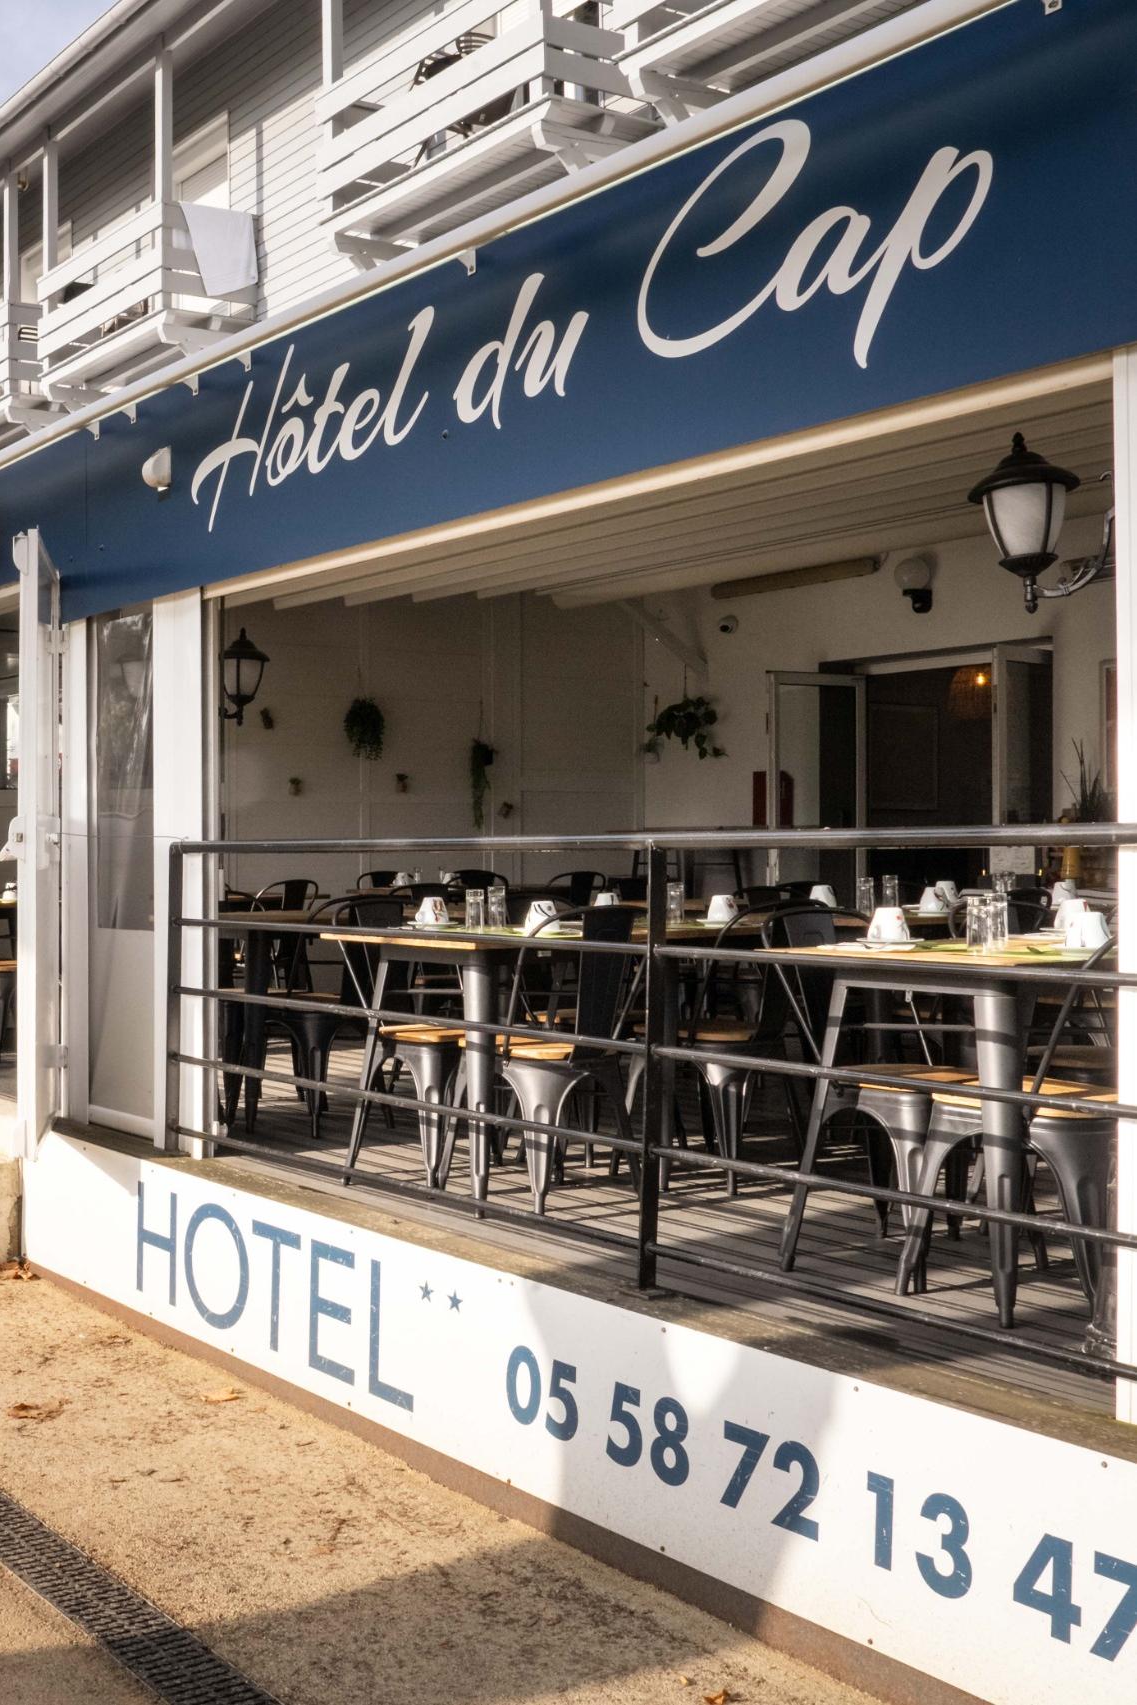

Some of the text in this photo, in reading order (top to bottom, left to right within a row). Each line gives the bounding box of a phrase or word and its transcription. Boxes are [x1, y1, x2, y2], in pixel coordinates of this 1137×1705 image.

[191, 120, 993, 532] Hôtel du Cap
[136, 1180, 414, 1413] HOTEL
[506, 1345, 1137, 1662] 05 58 72 13 47
